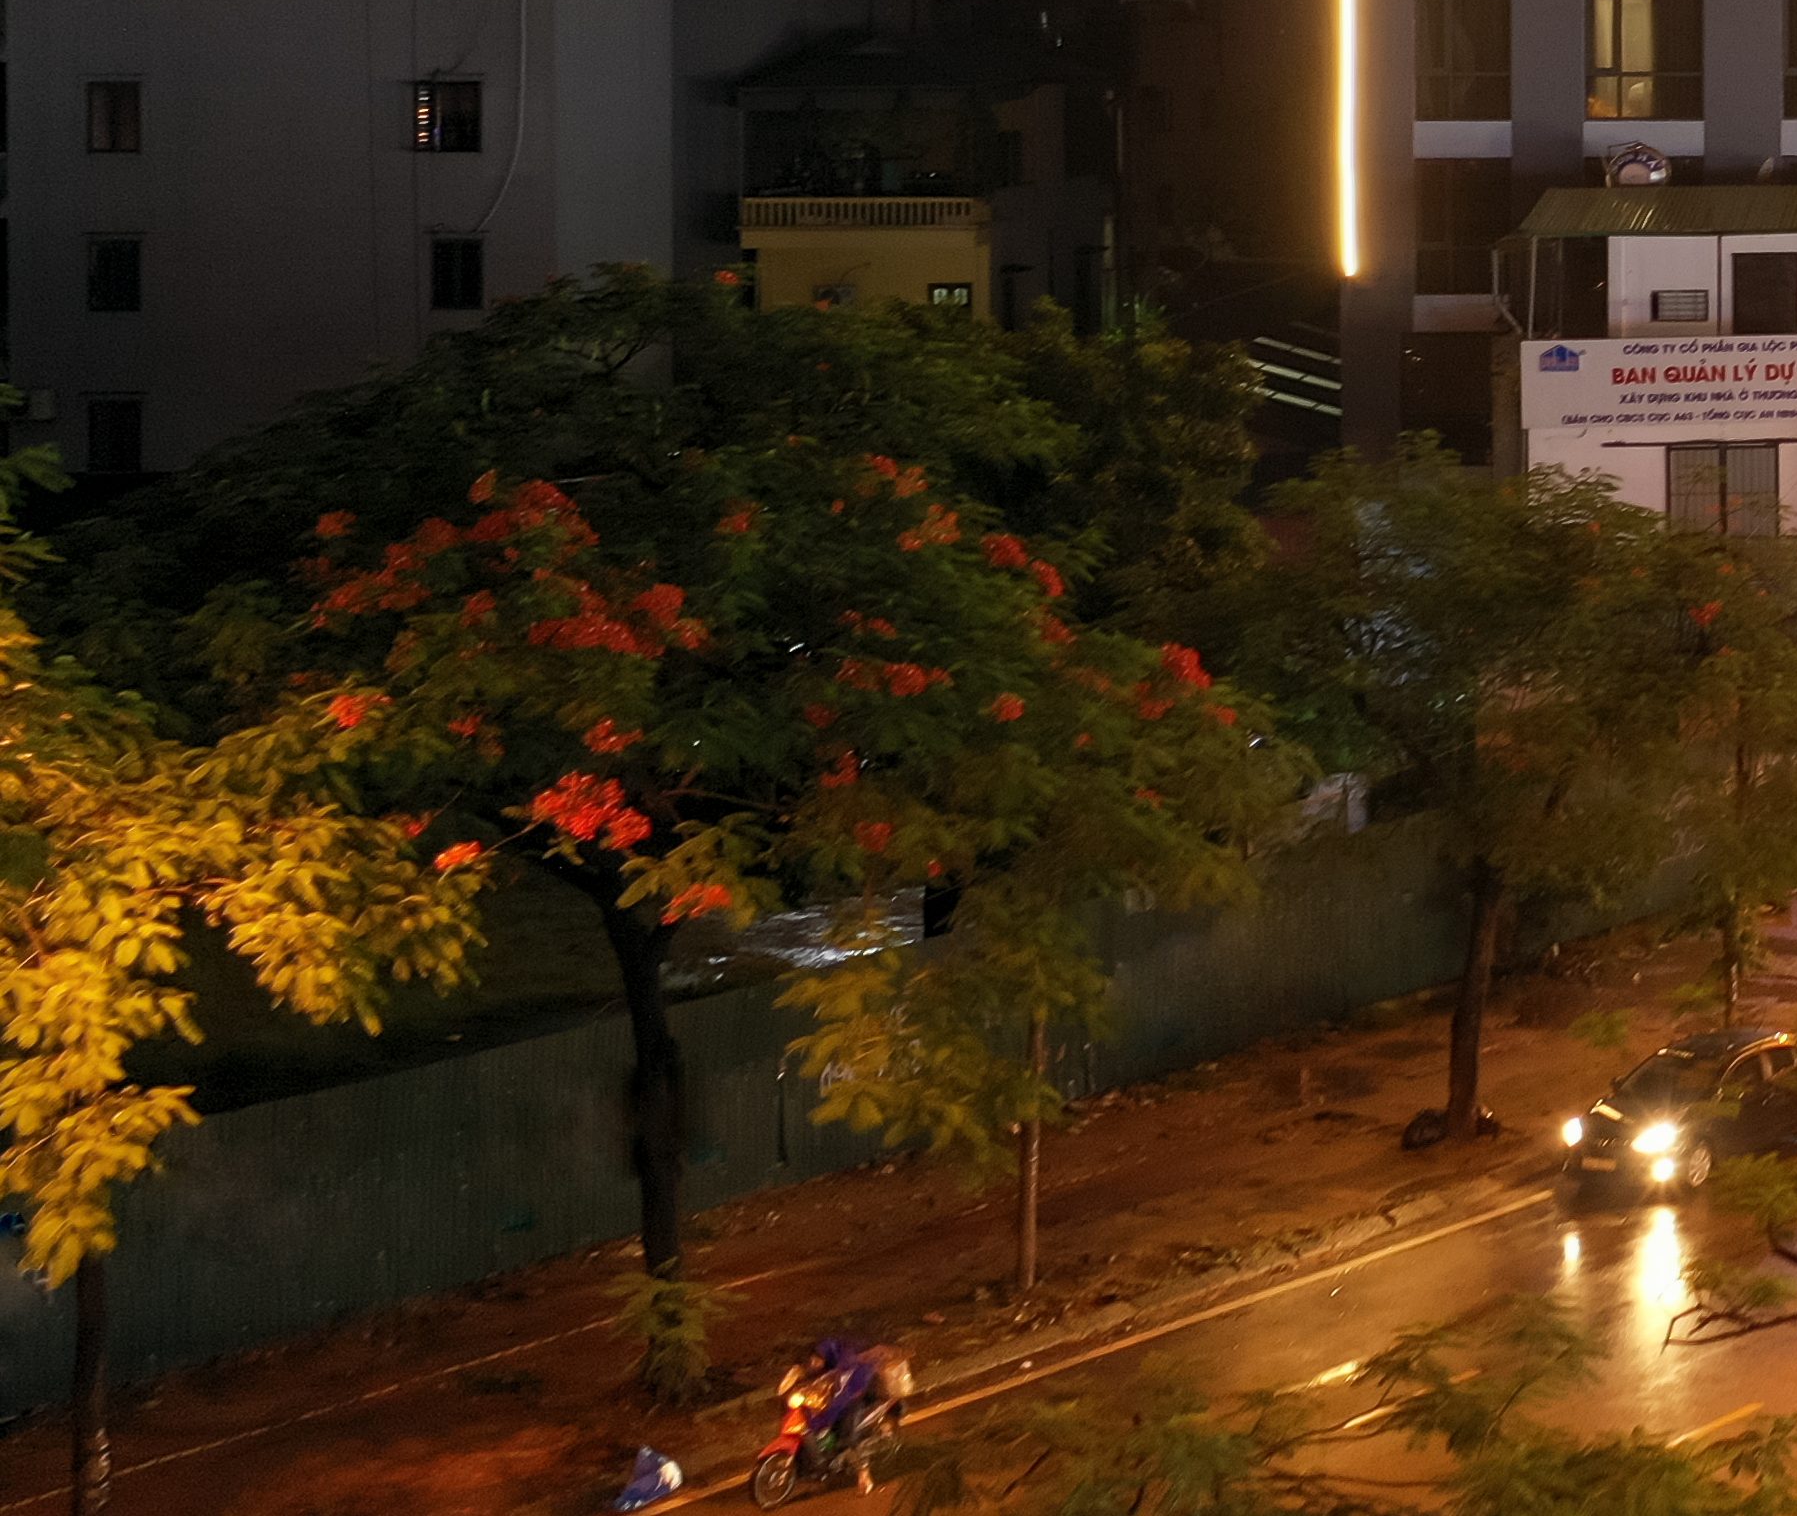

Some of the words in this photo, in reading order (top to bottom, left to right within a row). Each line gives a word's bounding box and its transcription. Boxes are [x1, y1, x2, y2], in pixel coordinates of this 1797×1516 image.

[1611, 367, 1657, 385] BAN
[1663, 358, 1727, 384] QUẢN
[1732, 358, 1758, 382] LÝ
[1765, 361, 1796, 385] DỰ
